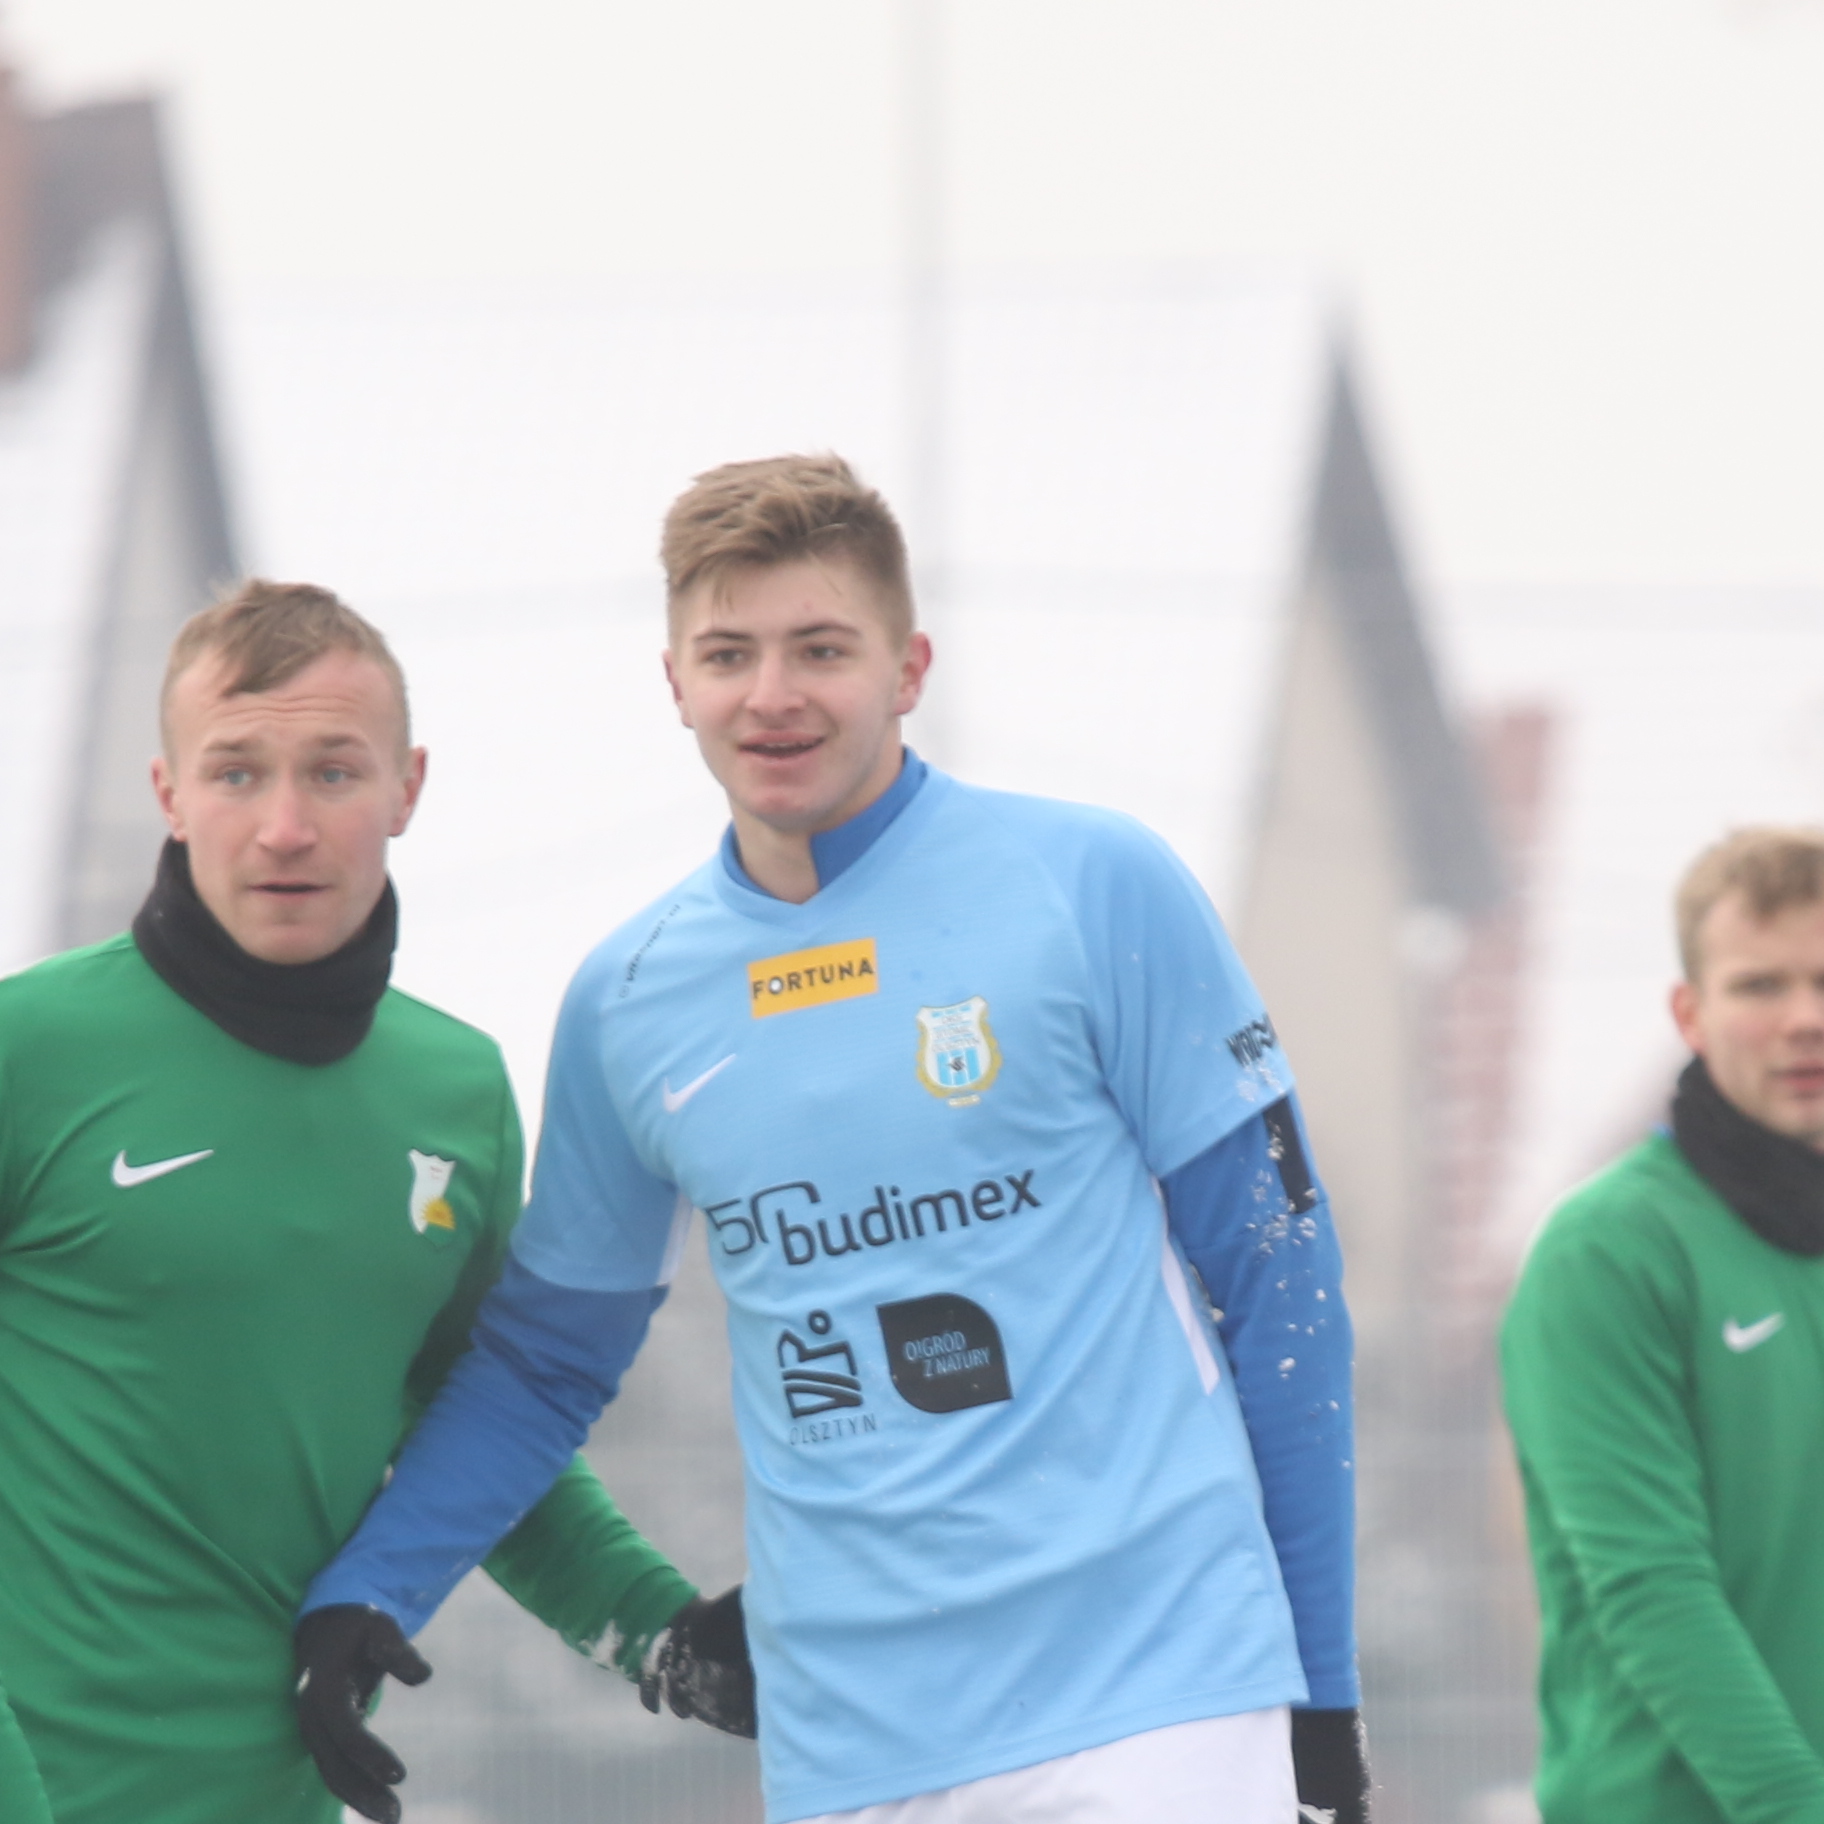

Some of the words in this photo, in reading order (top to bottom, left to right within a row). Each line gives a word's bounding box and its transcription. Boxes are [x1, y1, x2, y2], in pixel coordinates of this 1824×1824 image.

[752, 957, 874, 1000] FORTUNA
[776, 1169, 1042, 1266] budimex
[936, 1348, 991, 1374] NATURY
[789, 1412, 877, 1446] OLSZTYN
